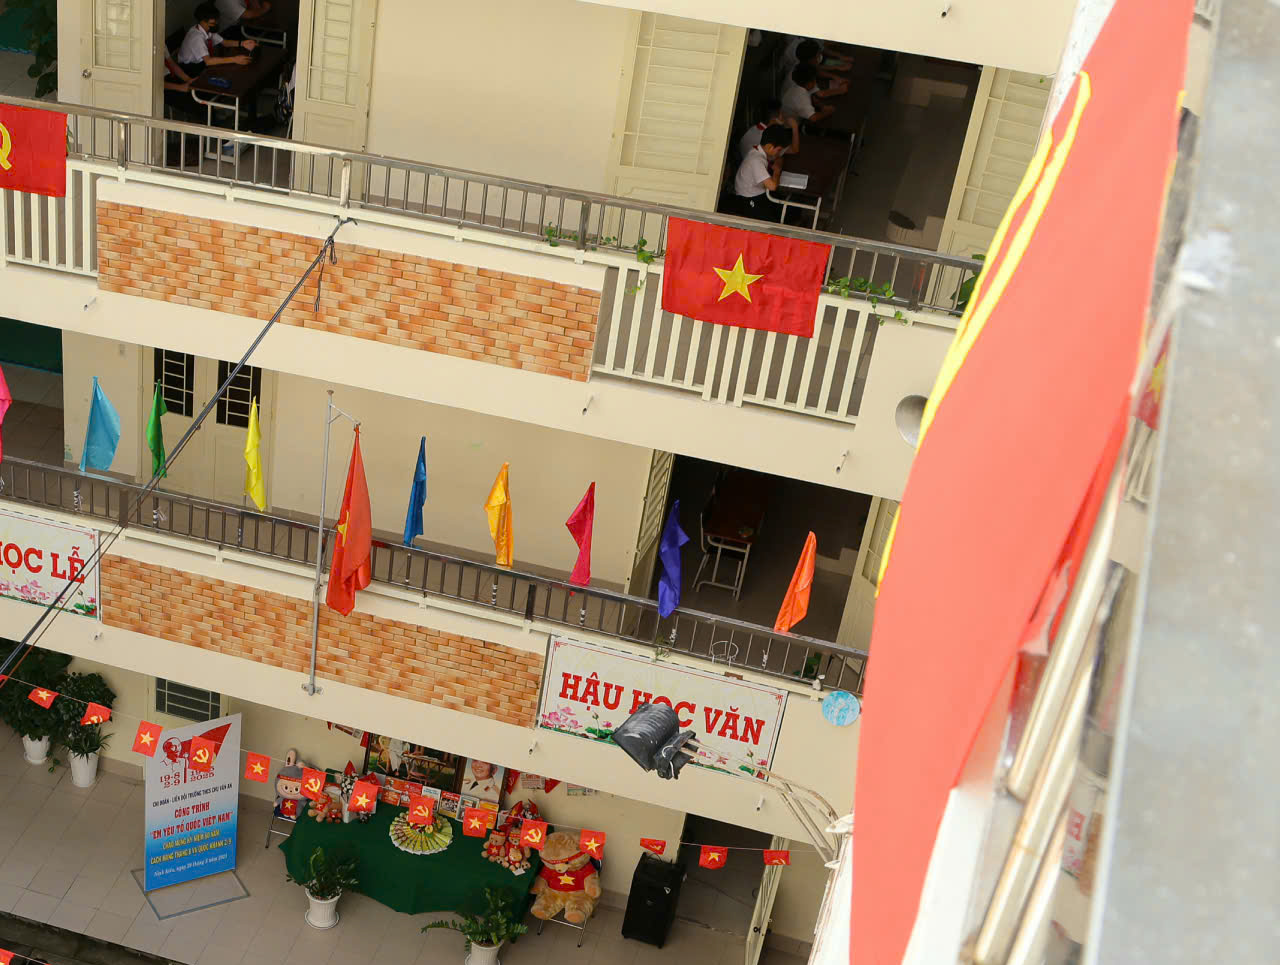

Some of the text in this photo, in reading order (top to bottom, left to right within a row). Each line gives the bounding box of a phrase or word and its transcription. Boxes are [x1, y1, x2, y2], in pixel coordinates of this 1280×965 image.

[50, 546, 85, 584] LỄ
[559, 672, 624, 711] HẬU
[704, 706, 766, 746] VĂN
[175, 801, 210, 818] CÔNG TRÌNH
[163, 825, 174, 837] YÊU
[176, 820, 184, 833] TỔ
[186, 819, 201, 831] QUỐC
[203, 815, 216, 827] VIỆT
